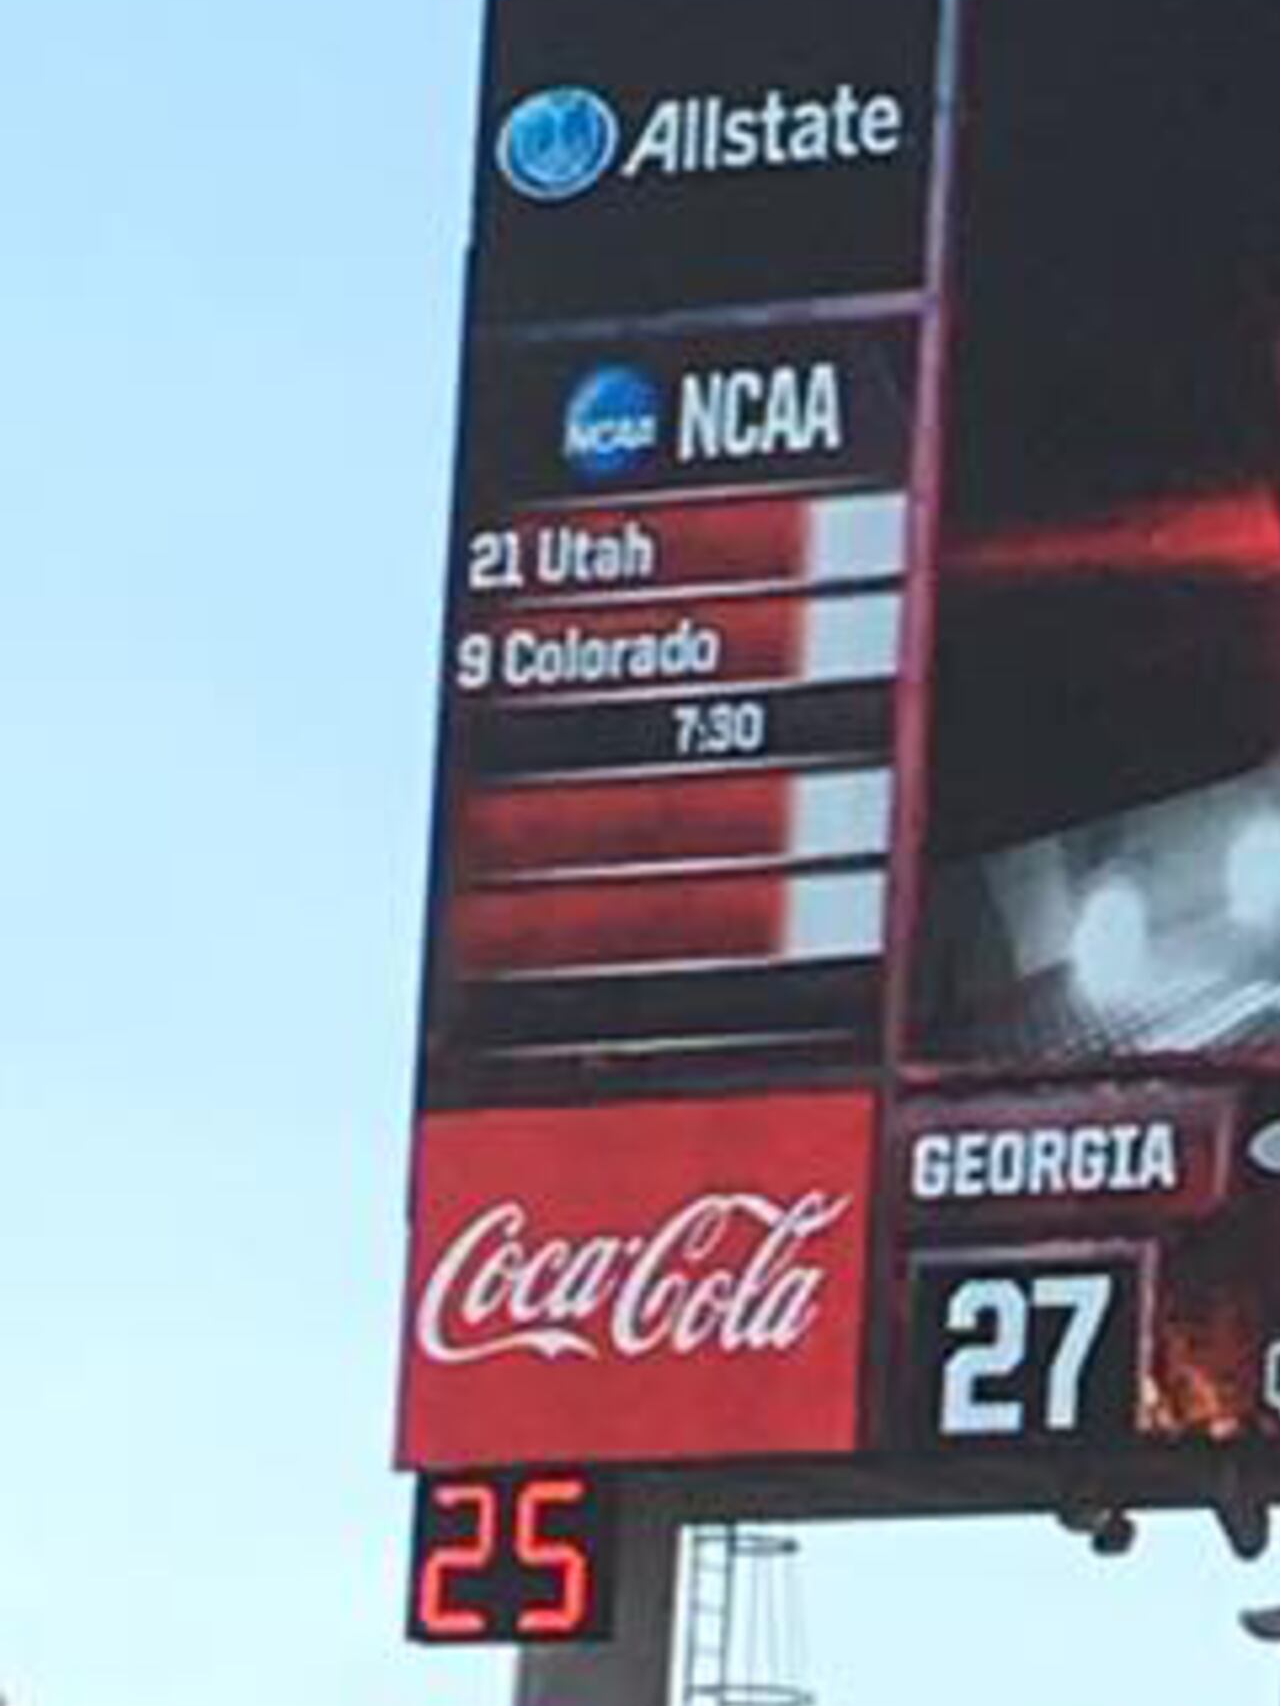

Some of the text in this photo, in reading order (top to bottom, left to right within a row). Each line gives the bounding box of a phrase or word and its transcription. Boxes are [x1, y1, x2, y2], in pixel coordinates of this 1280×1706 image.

[622, 86, 904, 175] Allstate
[676, 363, 842, 461] NCAA
[467, 522, 655, 589] 21 Utah
[455, 619, 720, 689] 9 Colorado
[672, 702, 763, 755] 7:30
[909, 1122, 1178, 1199] GEORGIA
[415, 1189, 852, 1363] Coca-Cola
[938, 1274, 1112, 1435] 27
[419, 1480, 587, 1635] 25
